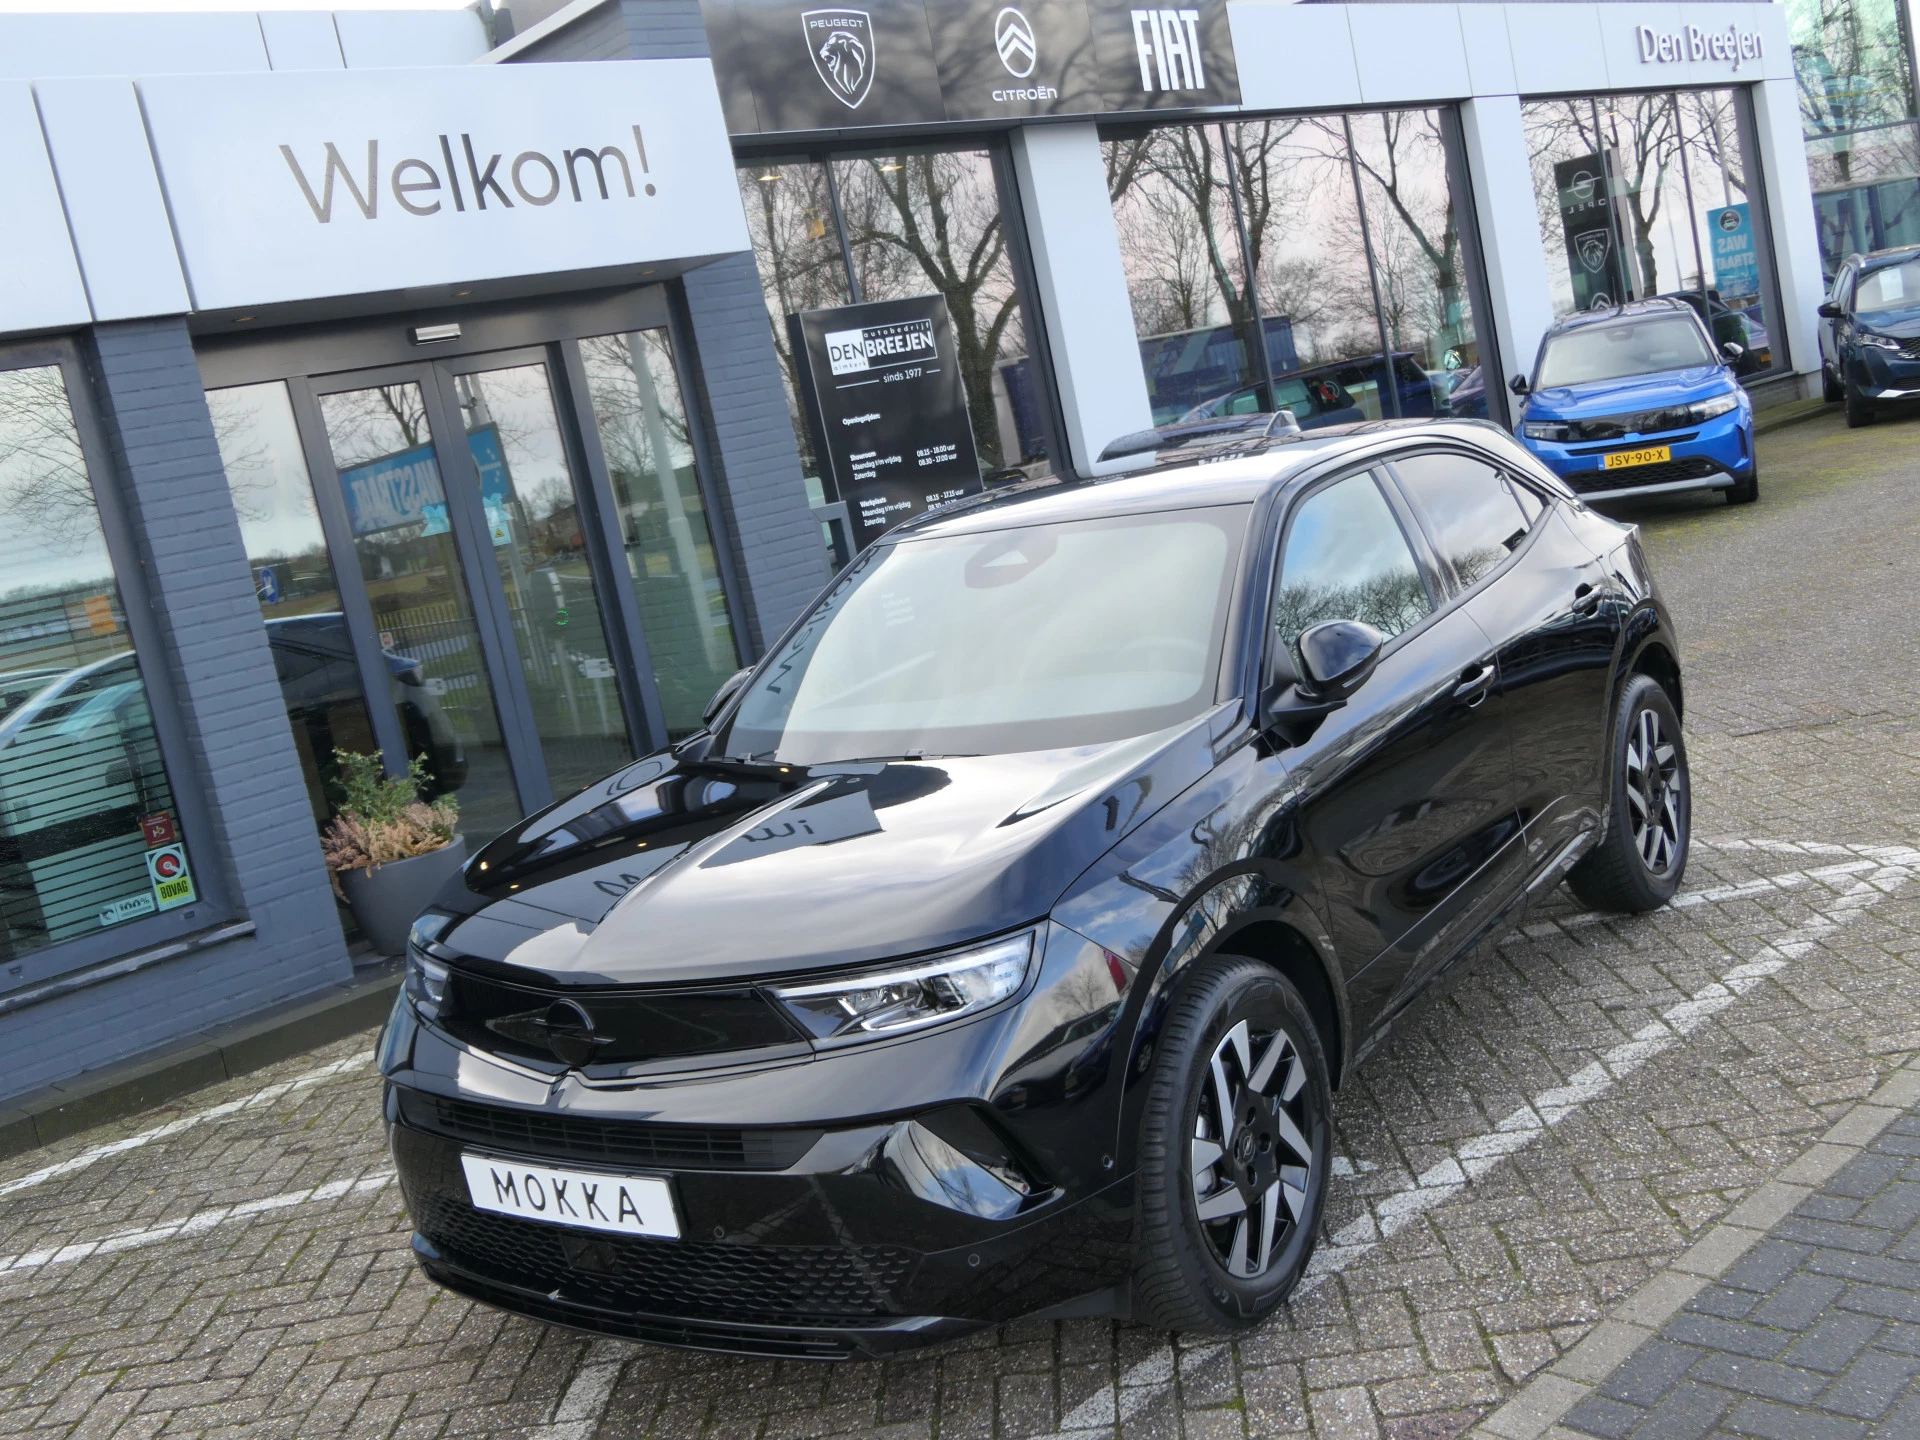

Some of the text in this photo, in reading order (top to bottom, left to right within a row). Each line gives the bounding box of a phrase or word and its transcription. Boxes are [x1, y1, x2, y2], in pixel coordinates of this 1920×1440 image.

[809, 18, 864, 29] PEUGEOT
[1130, 9, 1205, 92] FIAT
[1636, 23, 1765, 72] Den Breejen
[278, 124, 657, 224] Welkom!
[863, 321, 929, 338] autobedrijf
[830, 330, 934, 362] DEN BREEJEN
[883, 367, 922, 383] sinds 1977
[1608, 449, 1664, 467] JSV-90-X
[160, 880, 189, 900] BOVAG
[489, 1167, 644, 1226] MOKKA
